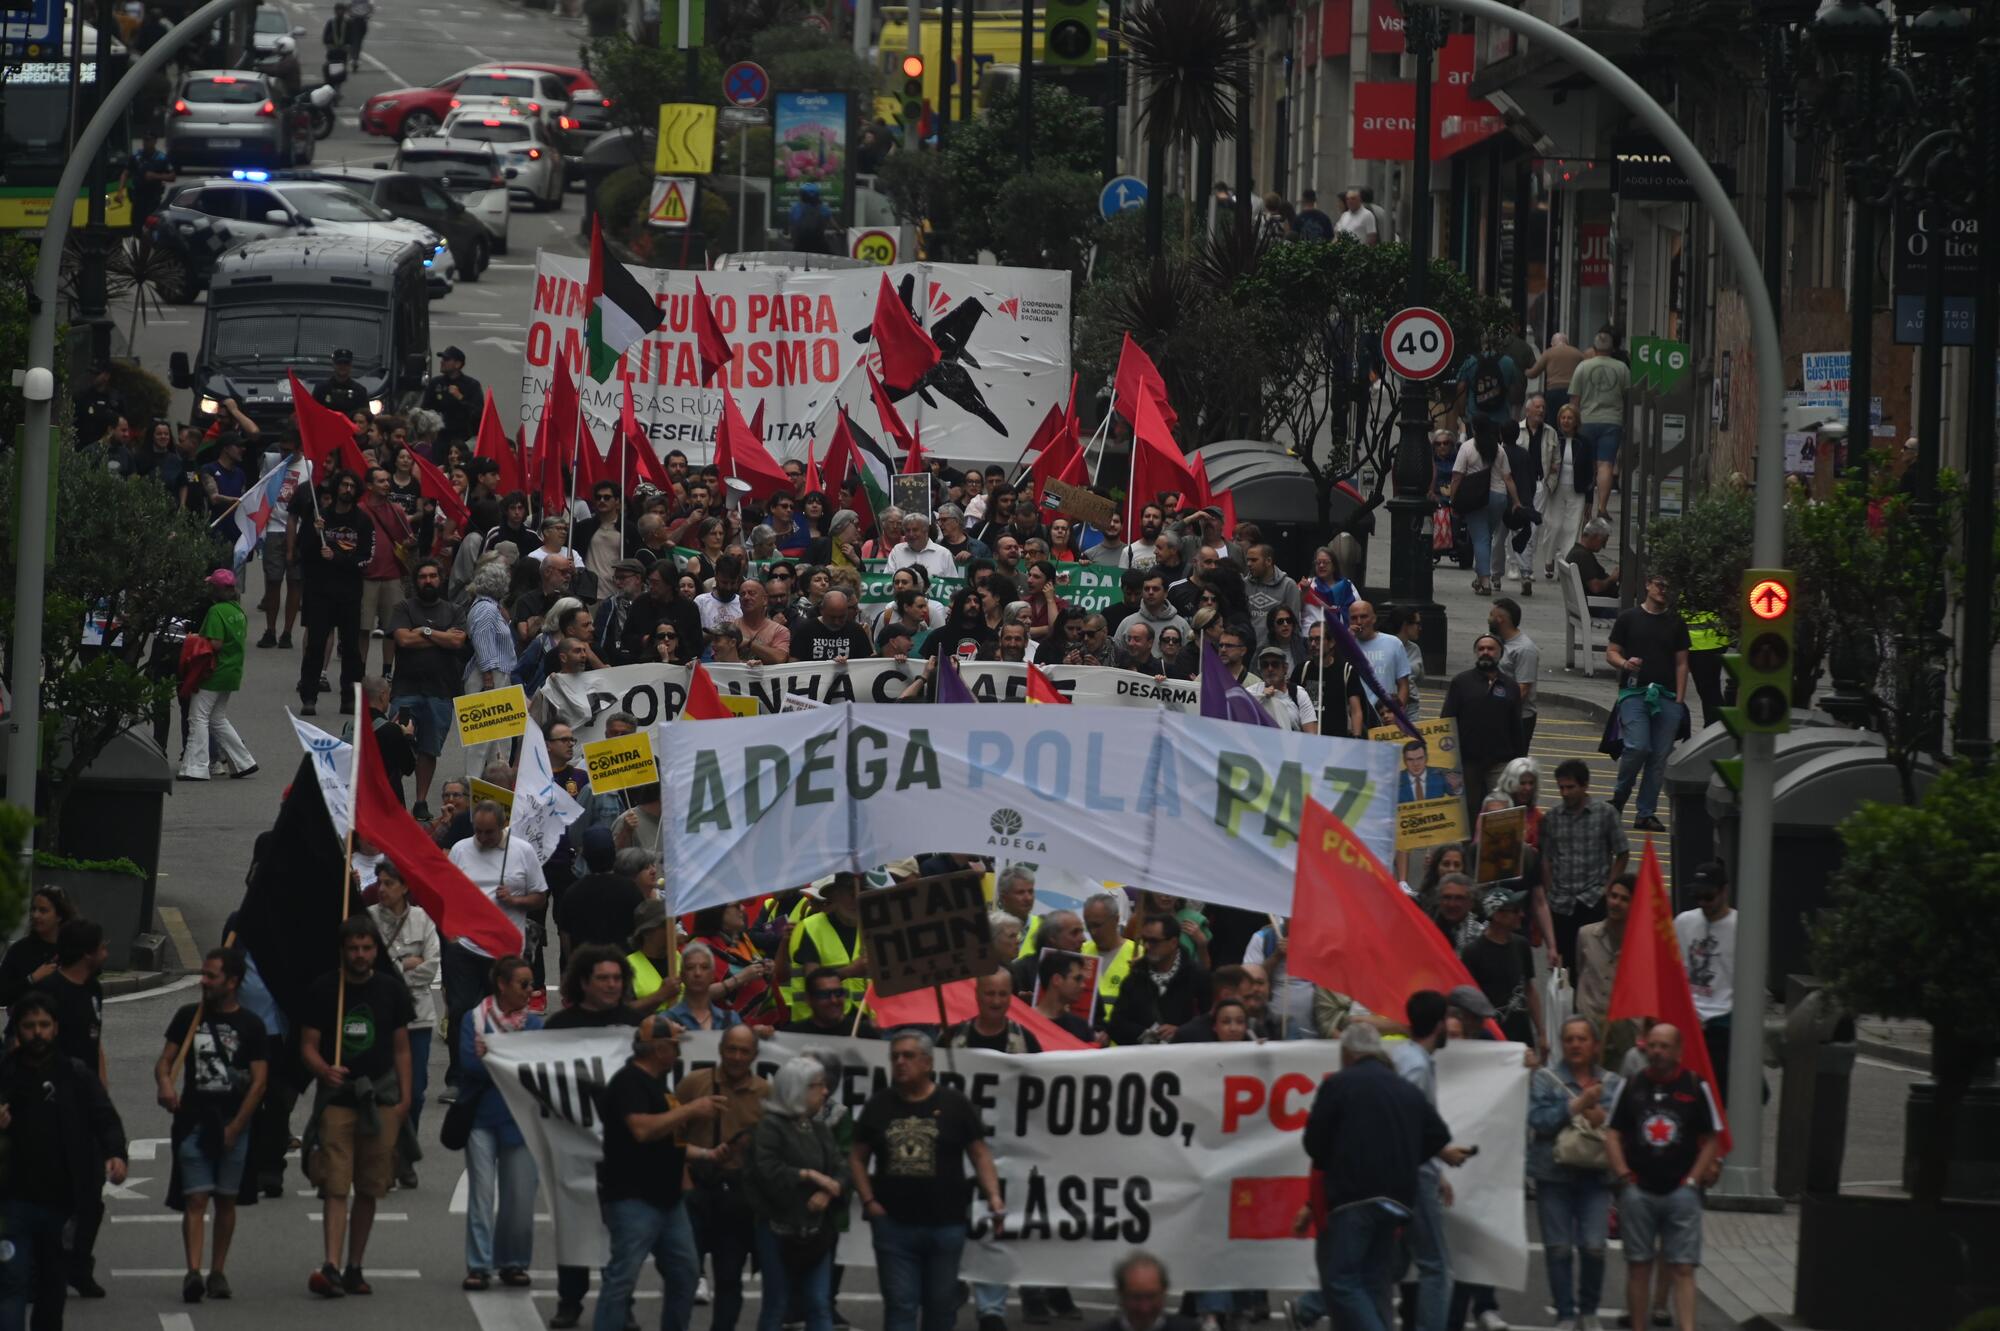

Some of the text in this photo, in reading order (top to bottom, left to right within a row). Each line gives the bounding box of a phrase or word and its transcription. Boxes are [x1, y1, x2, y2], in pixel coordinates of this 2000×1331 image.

[748, 295, 838, 333] PARA
[1917, 310, 1969, 320] CTRO
[527, 321, 551, 367] O
[1397, 330, 1439, 354] 40
[462, 725, 470, 733] O
[469, 711, 527, 732] REARMAMENTO
[592, 773, 599, 781] O
[599, 758, 654, 779] REARMAMENTO
[685, 725, 1375, 848] ADEGA POLA PAZ
[987, 836, 1048, 853] ADEGA
[861, 879, 985, 929] OTAN
[873, 911, 992, 967] NON
[1015, 1070, 1196, 1148] POBOS,
